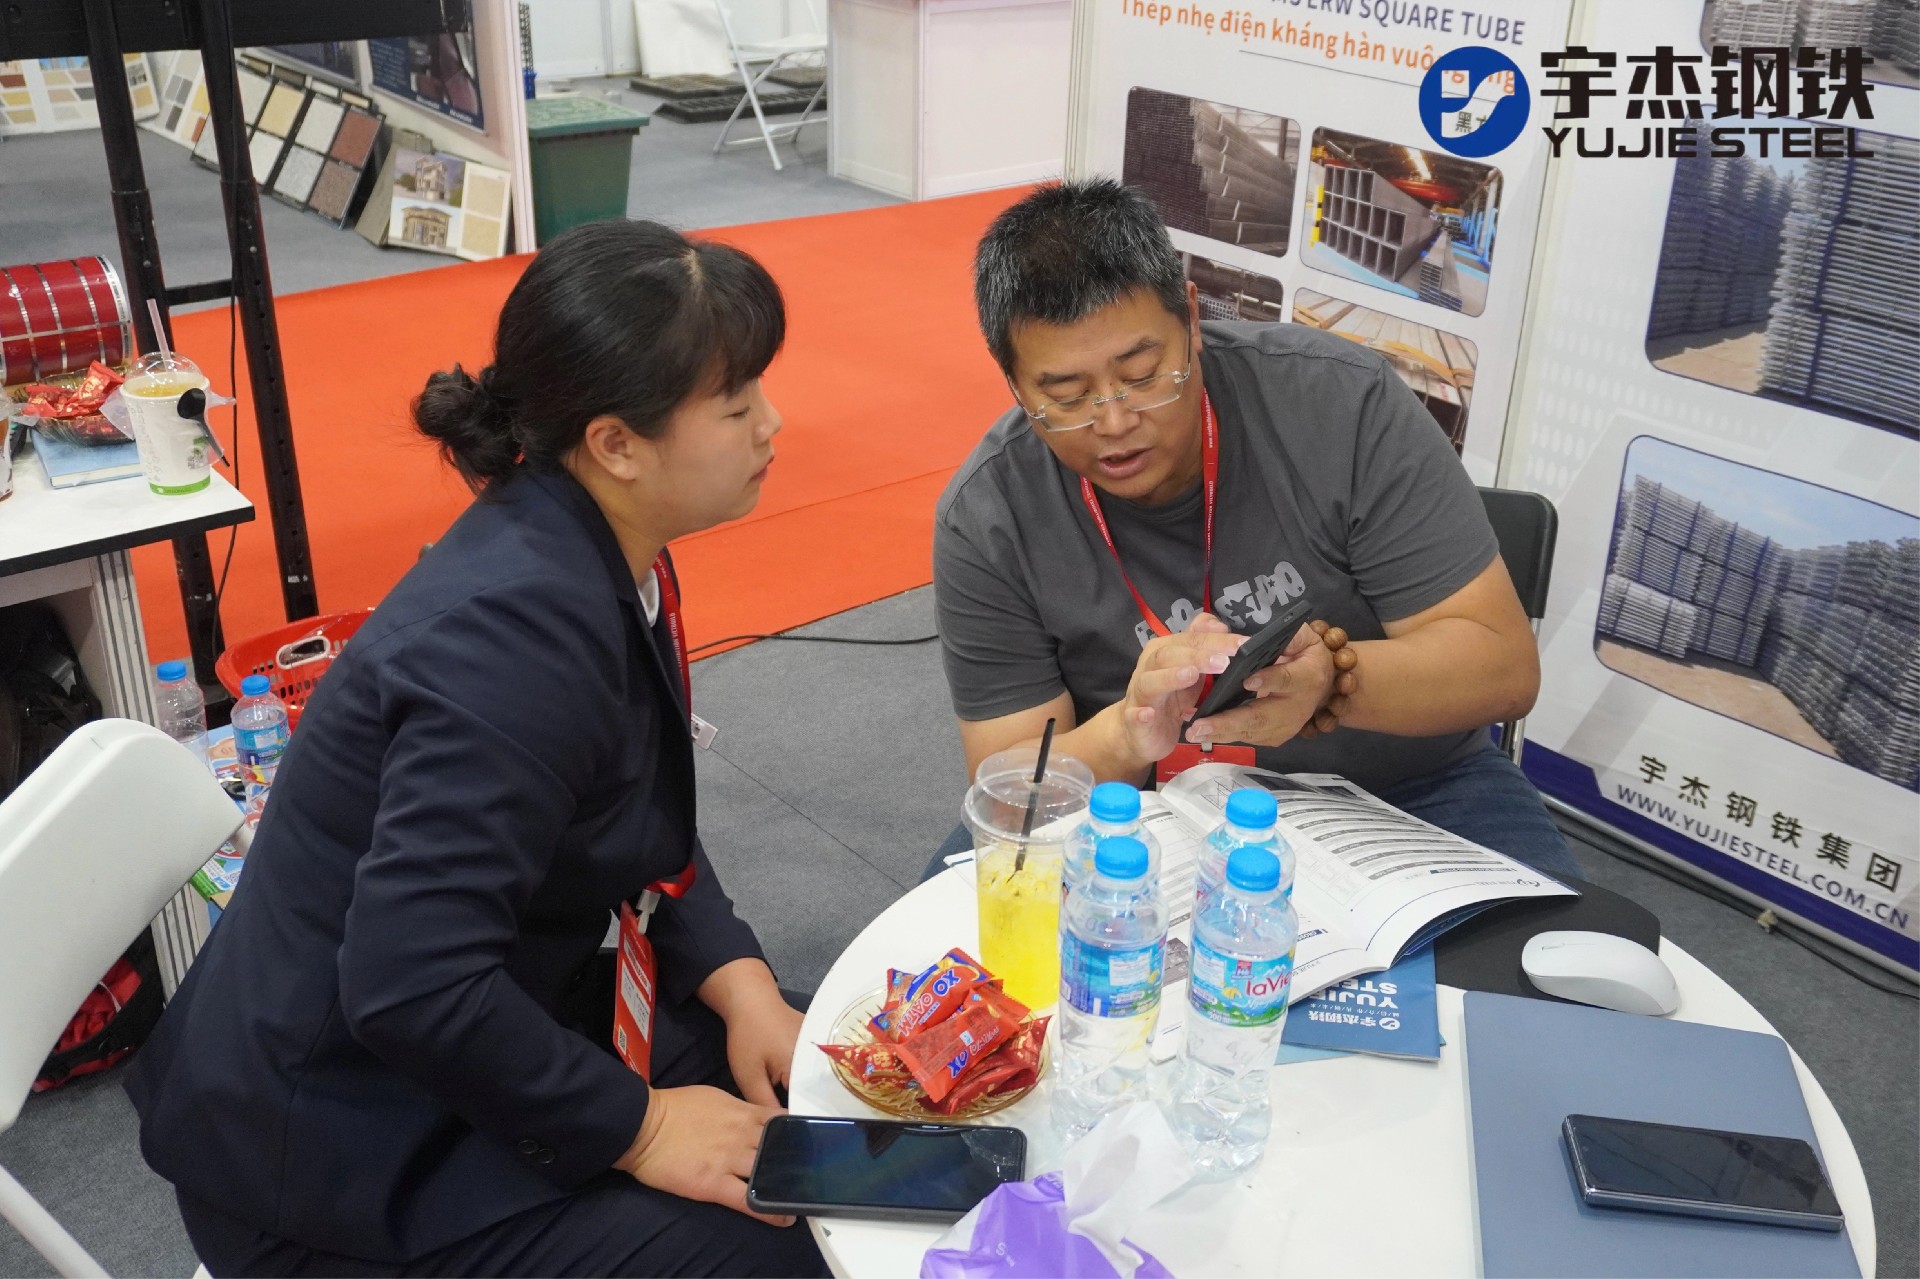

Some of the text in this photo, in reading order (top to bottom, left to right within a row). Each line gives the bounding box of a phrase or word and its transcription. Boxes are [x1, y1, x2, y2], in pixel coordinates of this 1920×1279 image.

[1177, 4, 1215, 35] nhẹ
[1220, 10, 1265, 42] điện
[1272, 18, 1338, 59] kháng
[1343, 31, 1385, 62] hàn
[1359, 0, 1454, 32] SQUARE
[1461, 11, 1526, 45] TUBE
[1639, 754, 1903, 893] 宇杰钢铁集团
[1617, 784, 1909, 930] WWW.YUJIESTEEL.COM.CN
[932, 967, 962, 998] XO
[1331, 978, 1398, 995] STE
